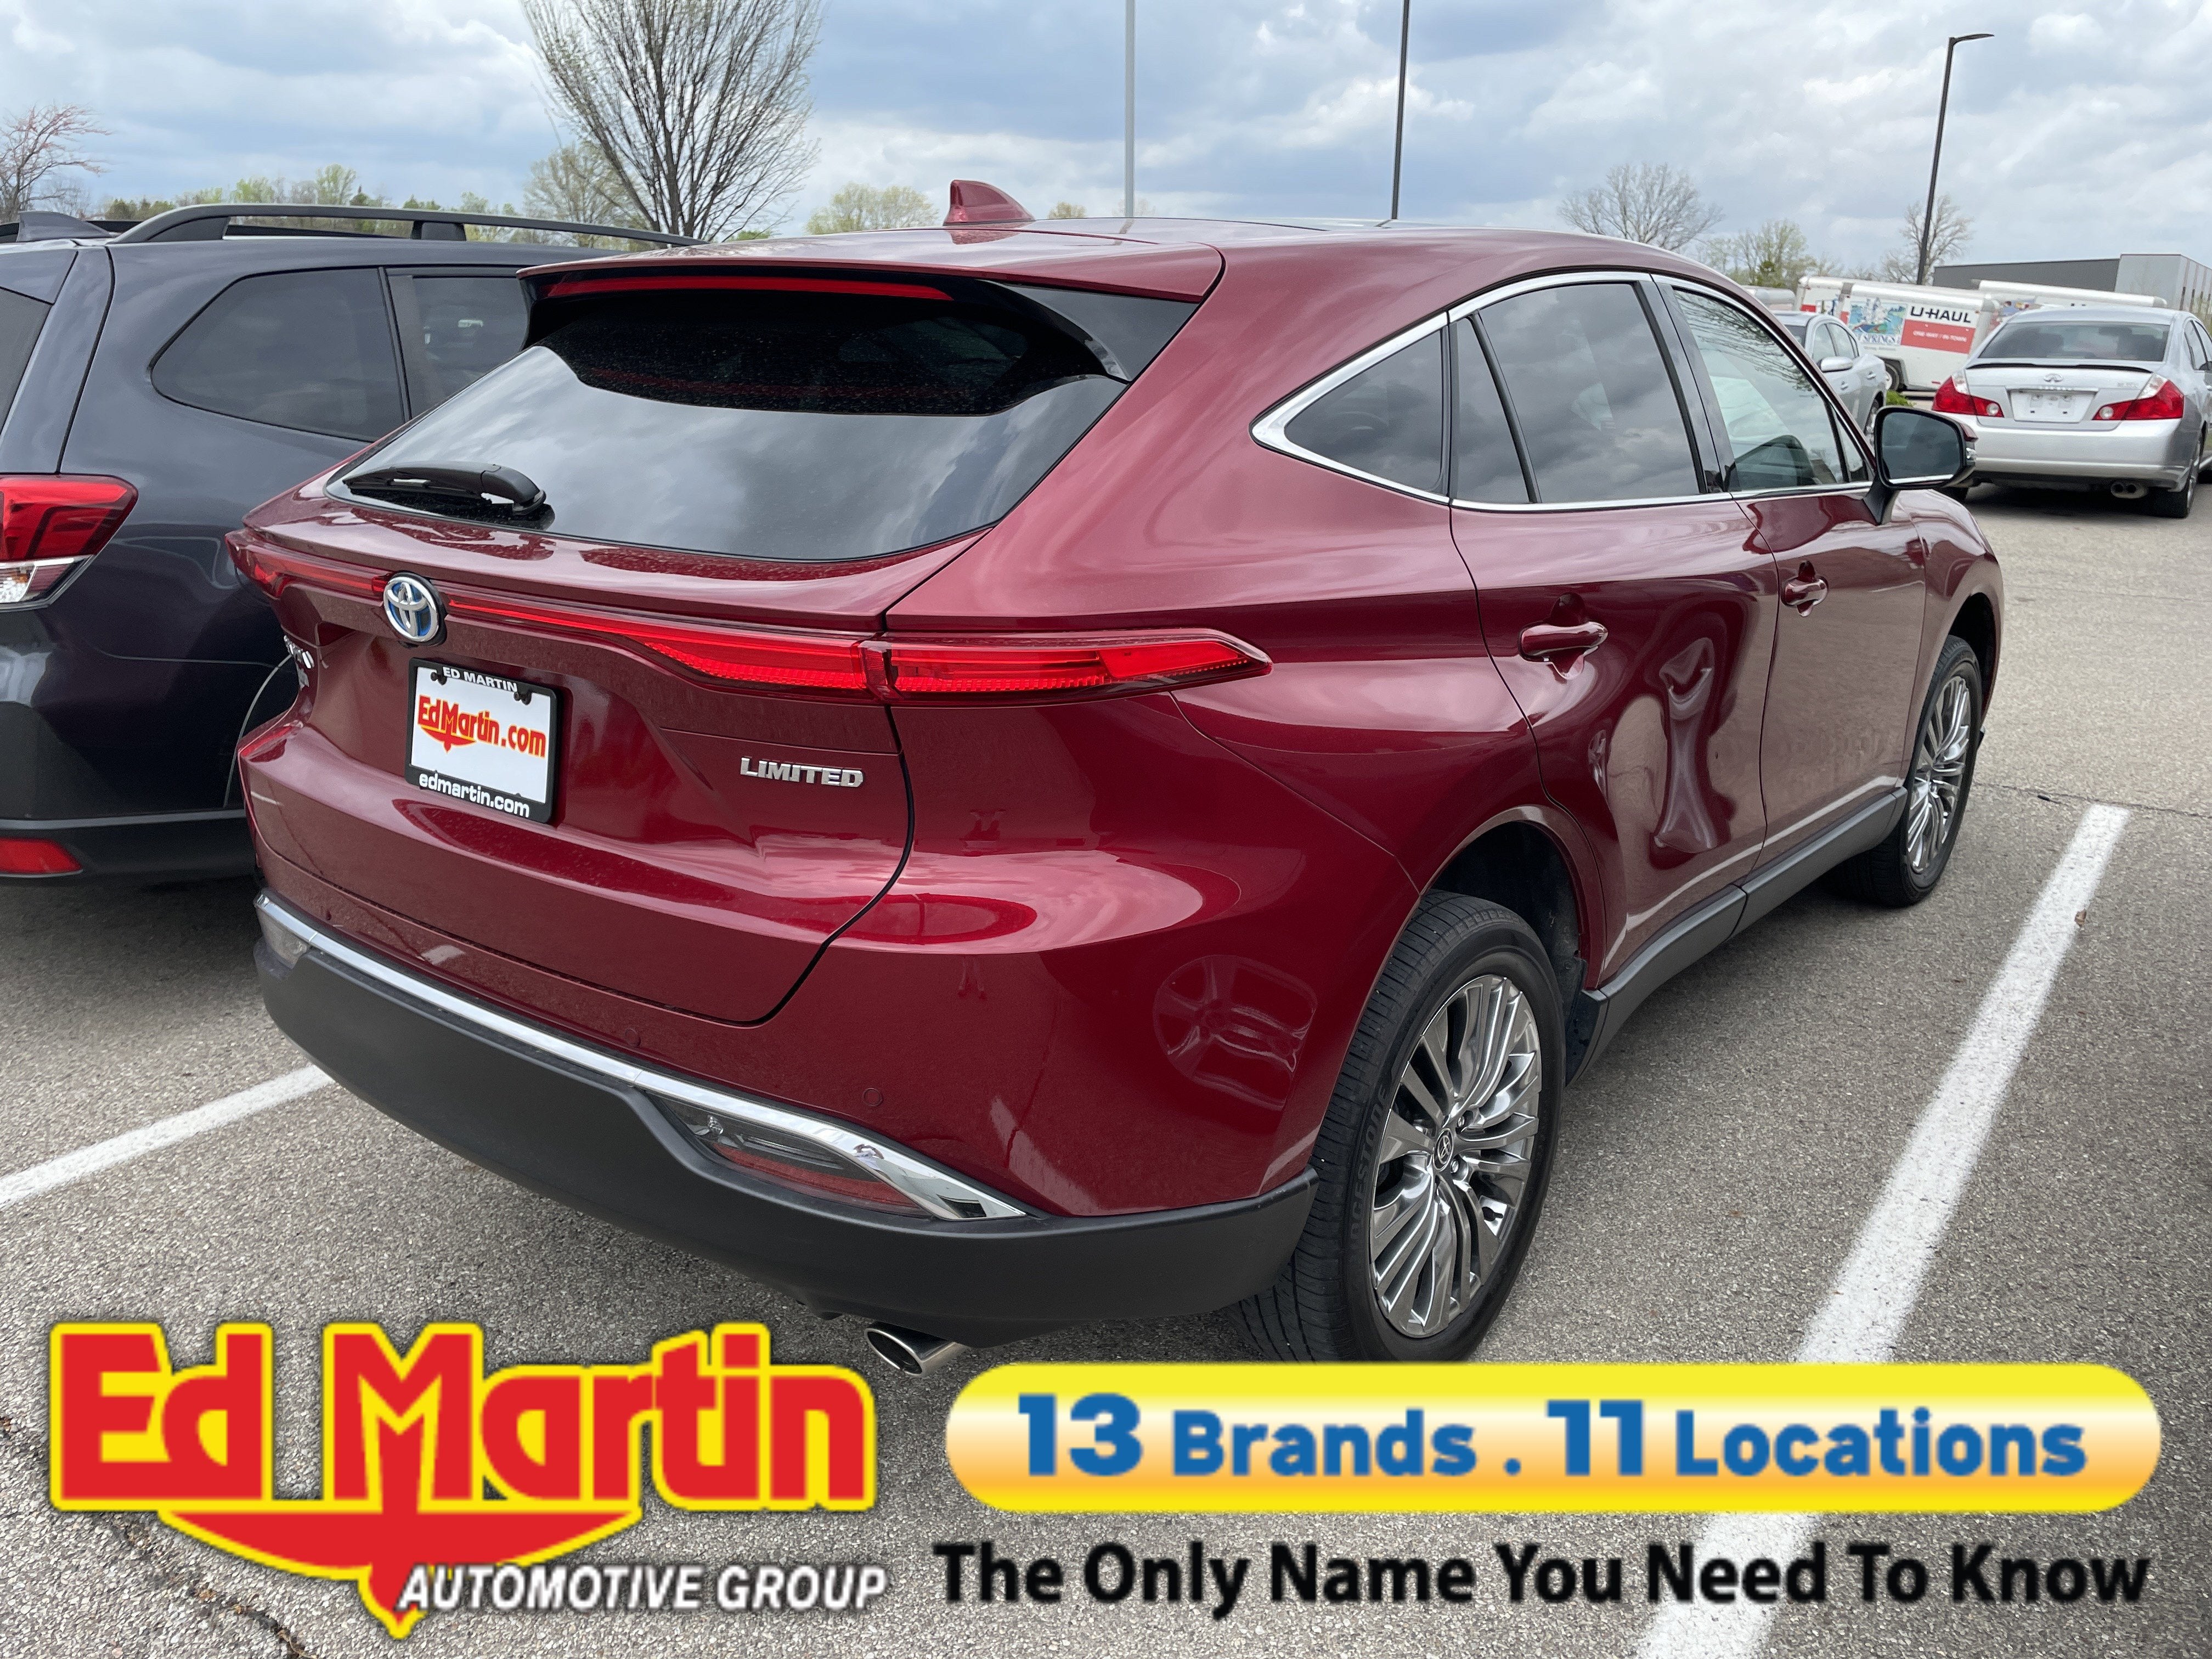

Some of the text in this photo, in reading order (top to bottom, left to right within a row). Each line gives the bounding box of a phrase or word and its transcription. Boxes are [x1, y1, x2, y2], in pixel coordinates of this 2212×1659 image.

[1910, 306, 1972, 324] U-HAUL
[442, 666, 518, 692] ED MARTIN
[417, 695, 546, 758] EdMartin.com
[741, 757, 864, 788] LIMITED
[419, 772, 531, 818] edmartin.com
